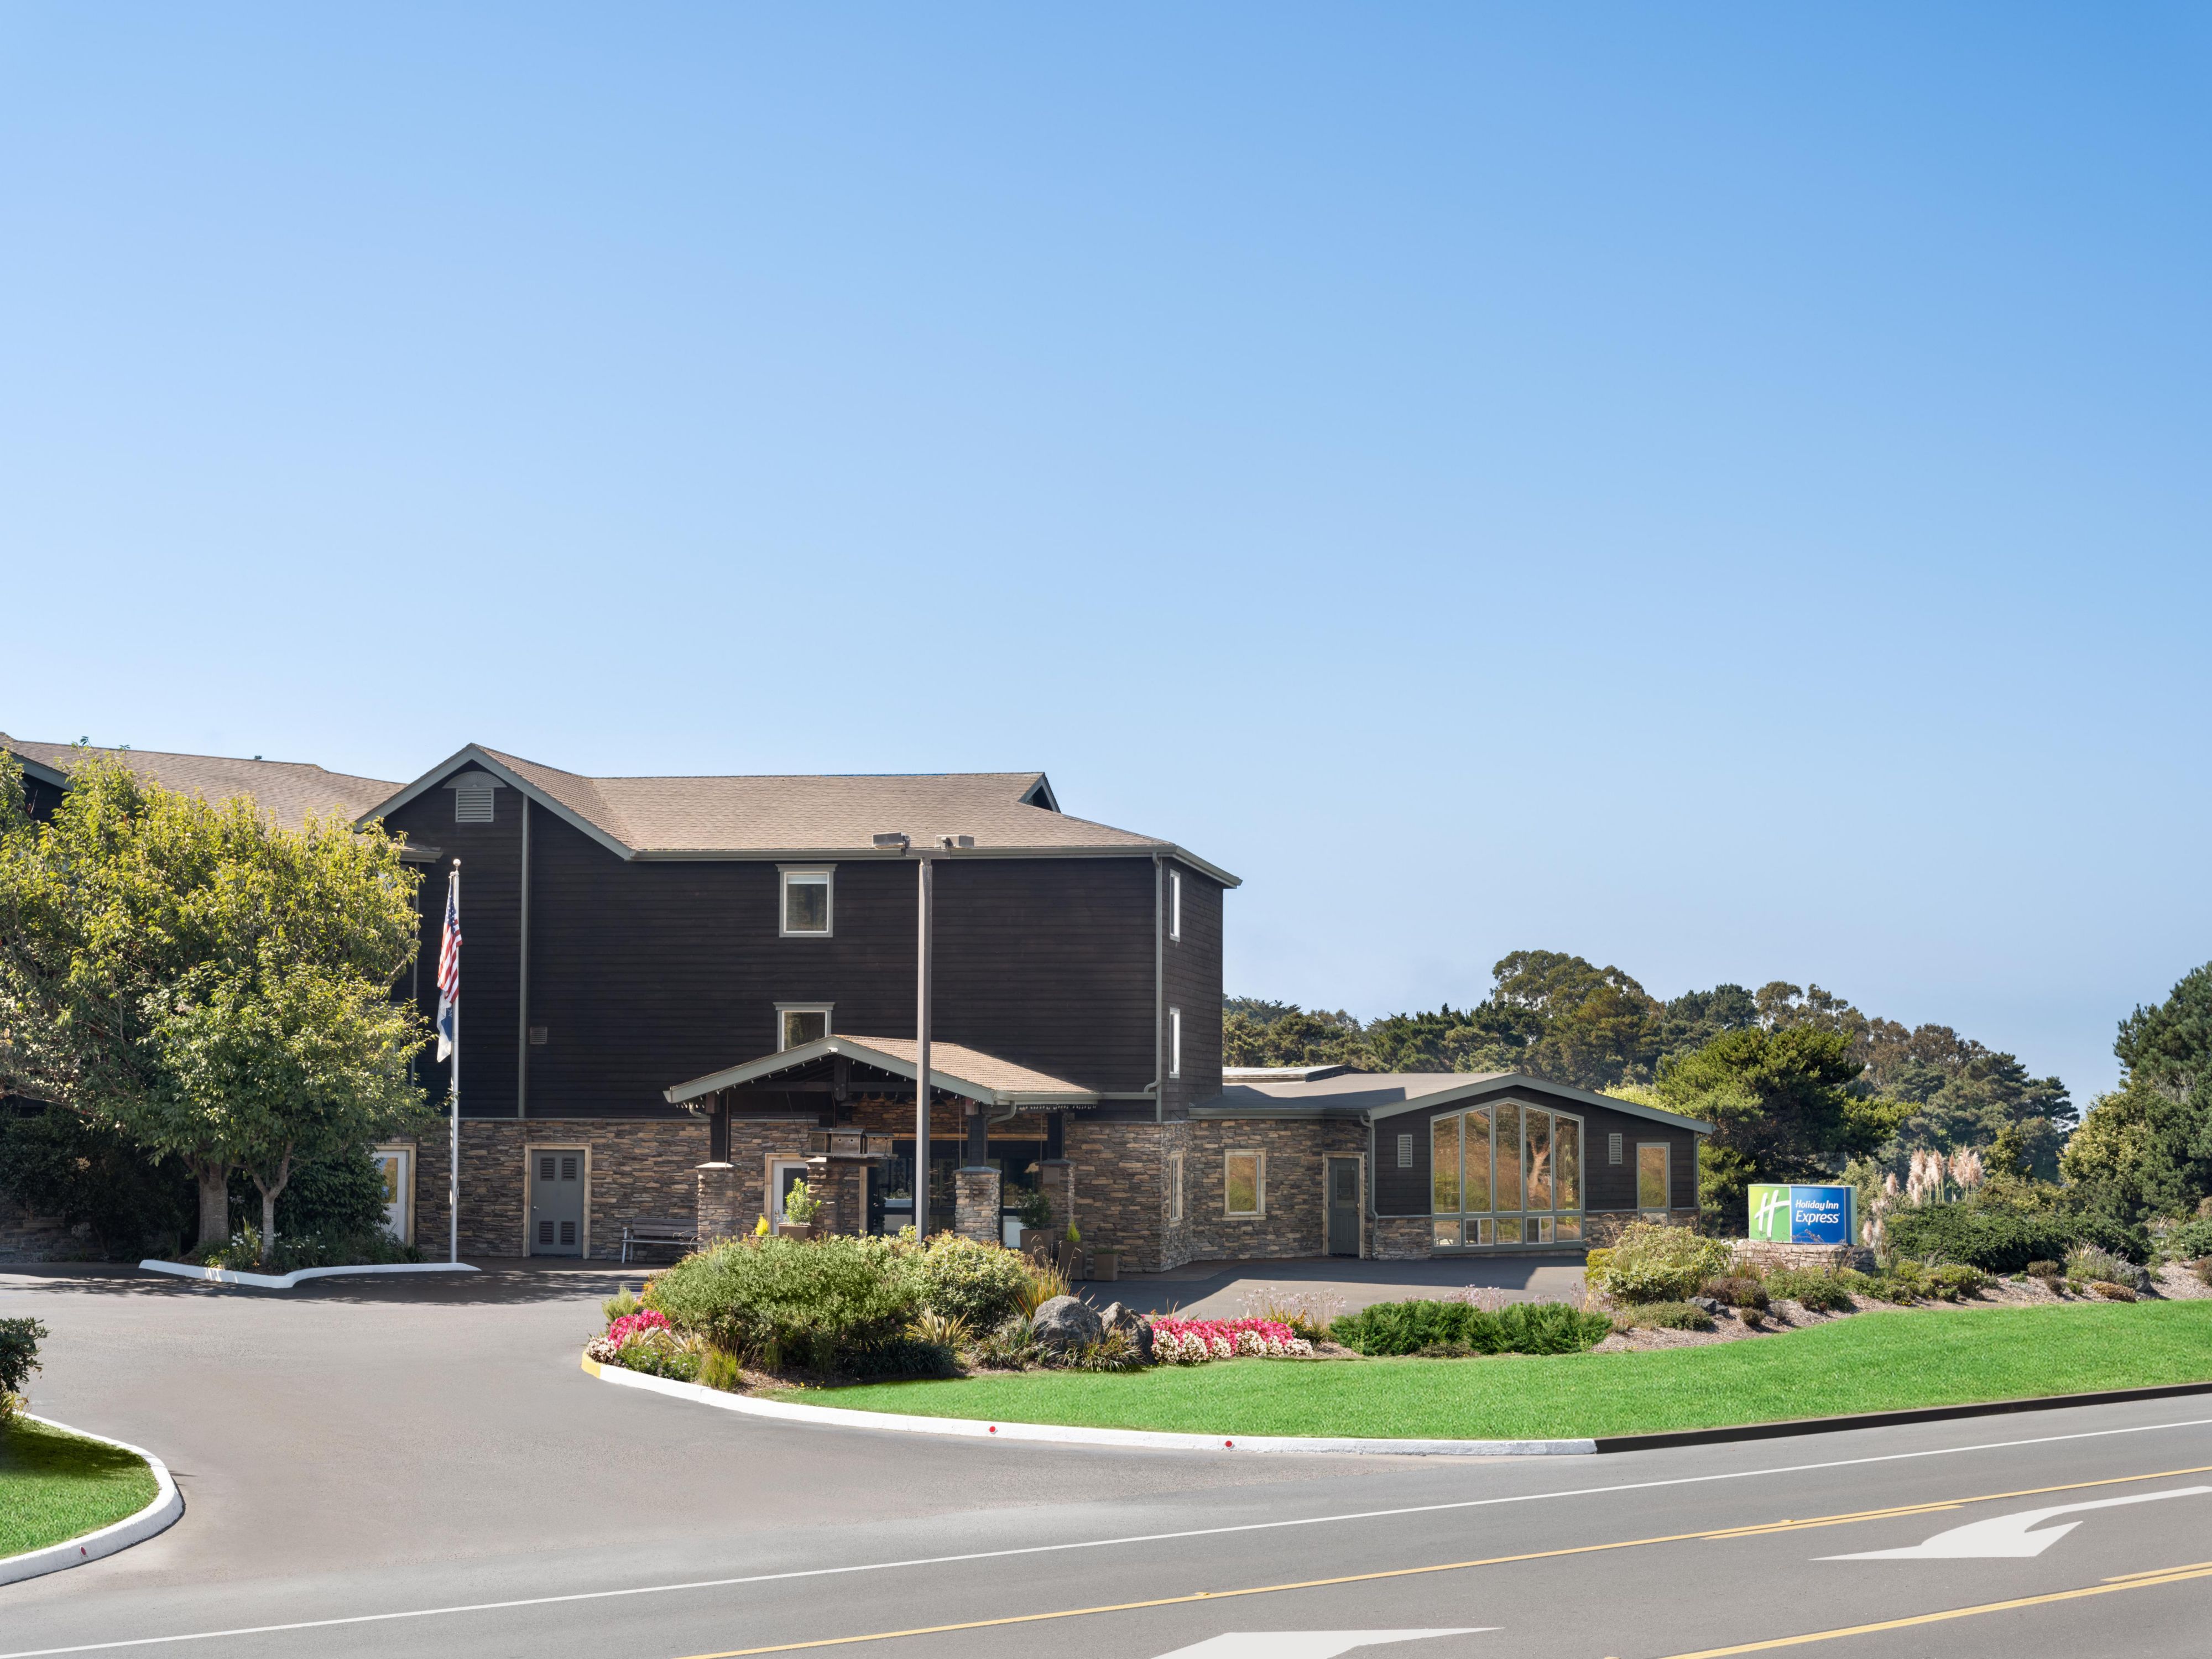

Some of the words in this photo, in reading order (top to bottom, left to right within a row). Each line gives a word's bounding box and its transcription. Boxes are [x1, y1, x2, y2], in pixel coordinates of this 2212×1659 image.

[1795, 1199, 1825, 1211] Holiday
[1825, 1199, 1839, 1209] Inn
[1795, 1210, 1839, 1226] Express
